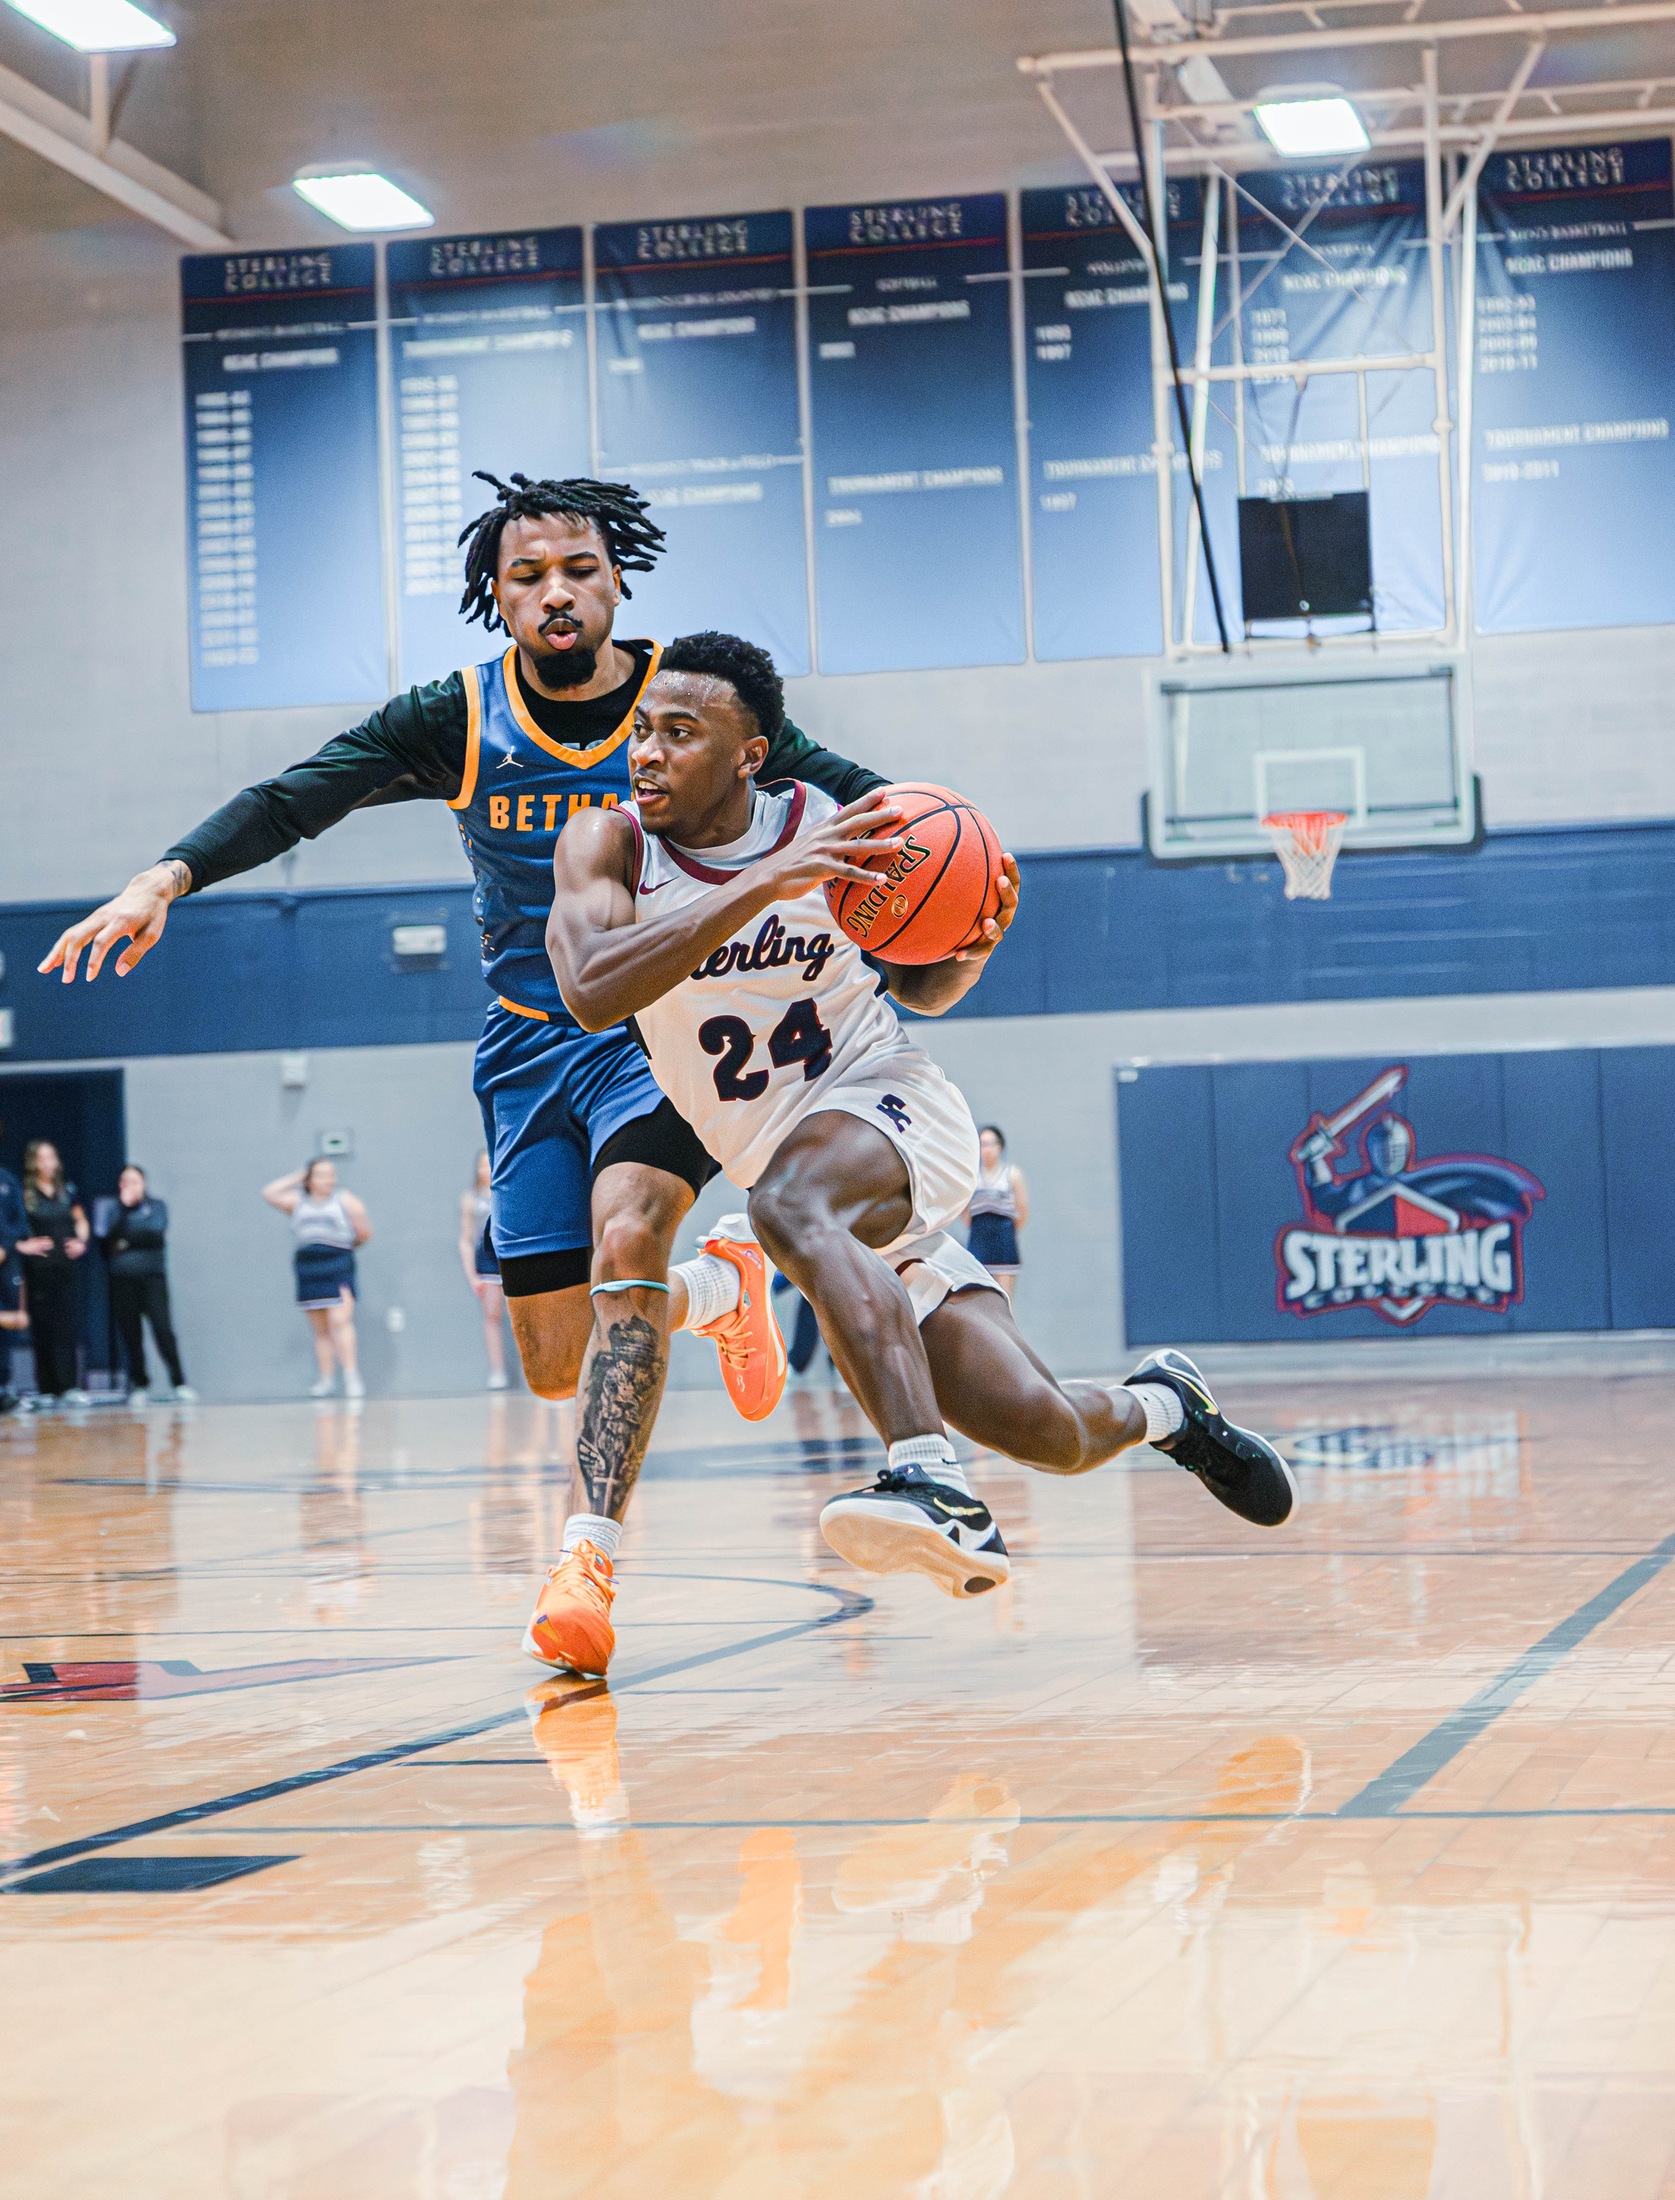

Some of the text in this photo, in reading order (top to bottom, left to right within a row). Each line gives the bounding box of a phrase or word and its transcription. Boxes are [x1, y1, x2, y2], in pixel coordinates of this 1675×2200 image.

[1506, 147, 1624, 173] STERLING
[1507, 167, 1624, 192] COLLEGE
[848, 203, 962, 225] STERLING
[637, 220, 748, 241] STERLING
[849, 218, 961, 243] COLLEGE
[431, 236, 539, 256] STERLING
[637, 236, 747, 259] COLLEGE
[225, 253, 331, 274] STERLING
[430, 252, 538, 274] COLLEGE
[1549, 247, 1633, 272] CHAMPIONS
[225, 268, 331, 293] COLLEGE
[1583, 417, 1670, 441] CHAMPIONS
[690, 914, 834, 981] erling
[698, 997, 833, 1101] 24
[1284, 1222, 1512, 1300] STERLING
